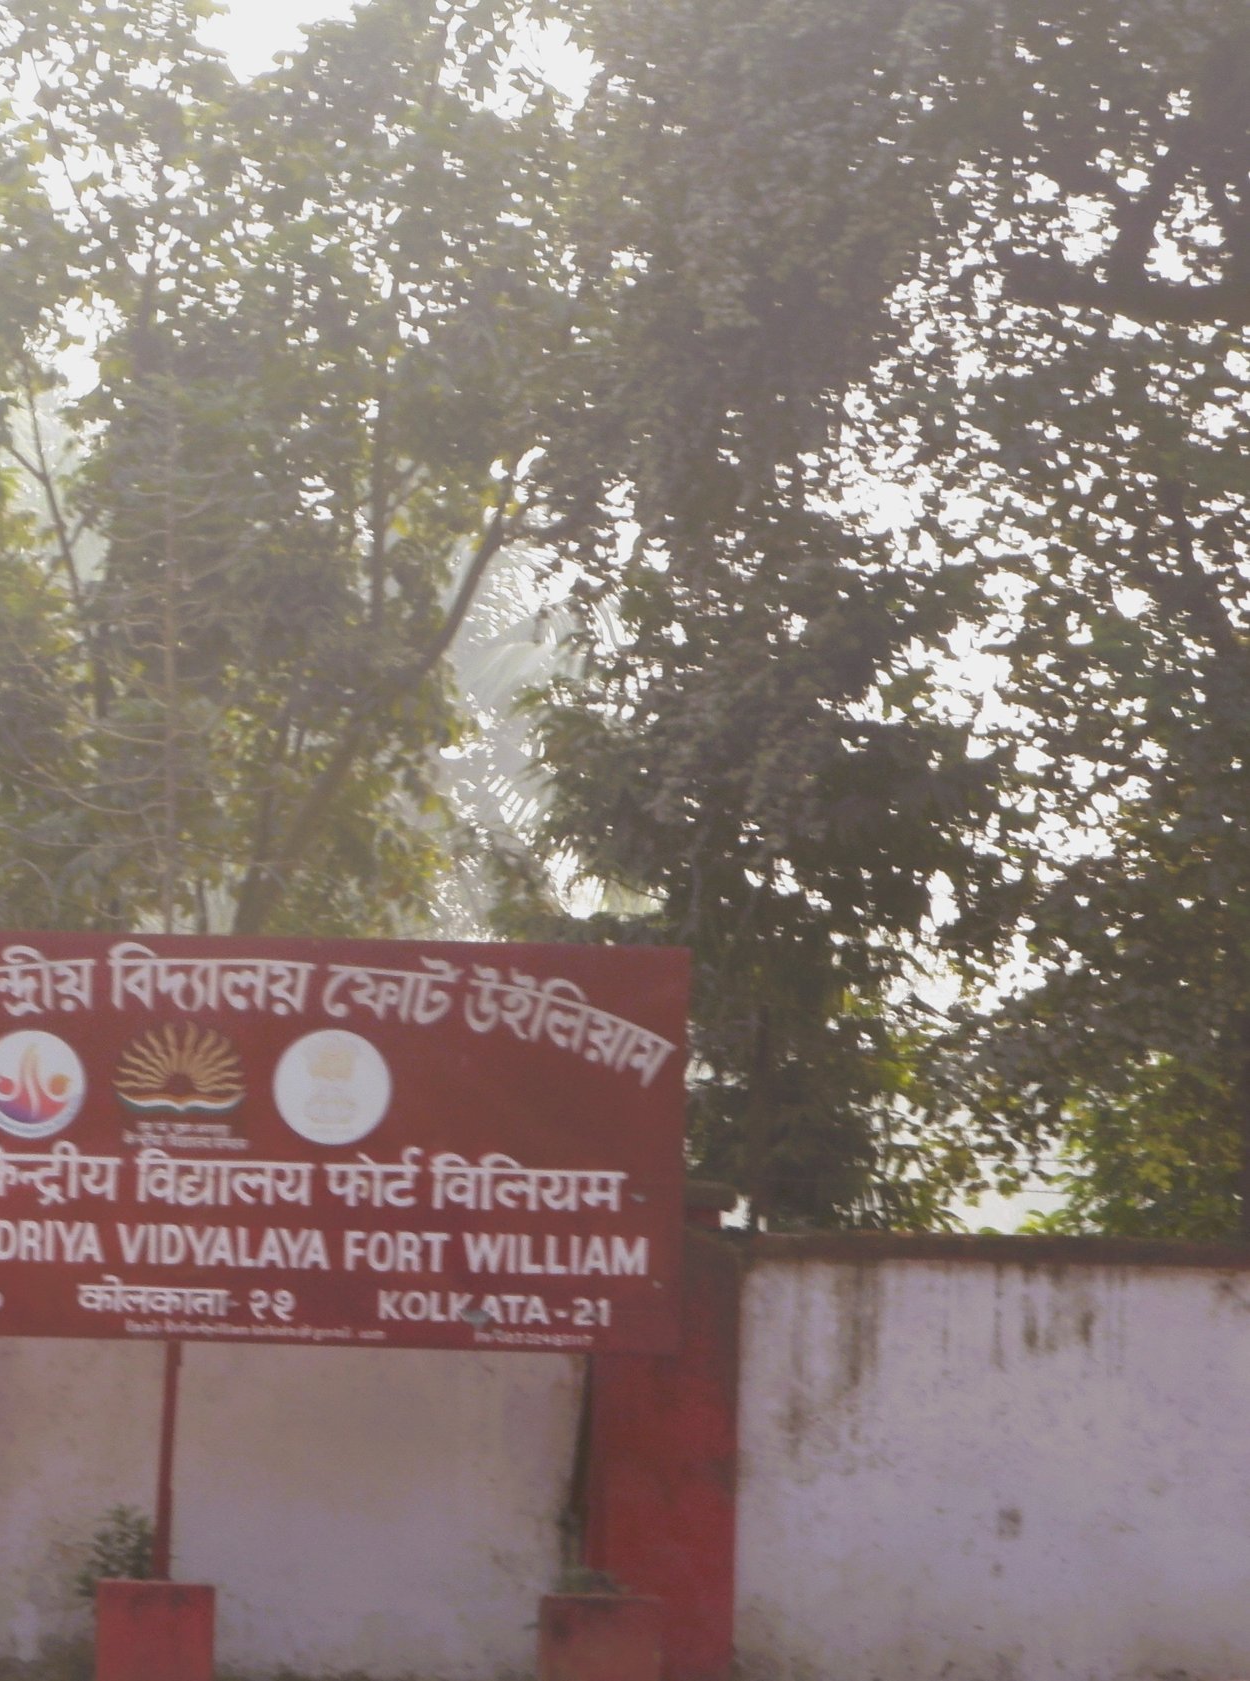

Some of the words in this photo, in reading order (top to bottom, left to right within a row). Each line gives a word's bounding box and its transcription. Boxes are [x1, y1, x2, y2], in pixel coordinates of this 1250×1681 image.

[134, 1148, 315, 1206] विद्यालय
[323, 1147, 425, 1207] फोर्ट
[429, 1152, 629, 1212] विलियम
[116, 1223, 330, 1271] VIDYALAYA
[343, 1231, 451, 1274] FORT
[461, 1233, 649, 1276] WILLIAM
